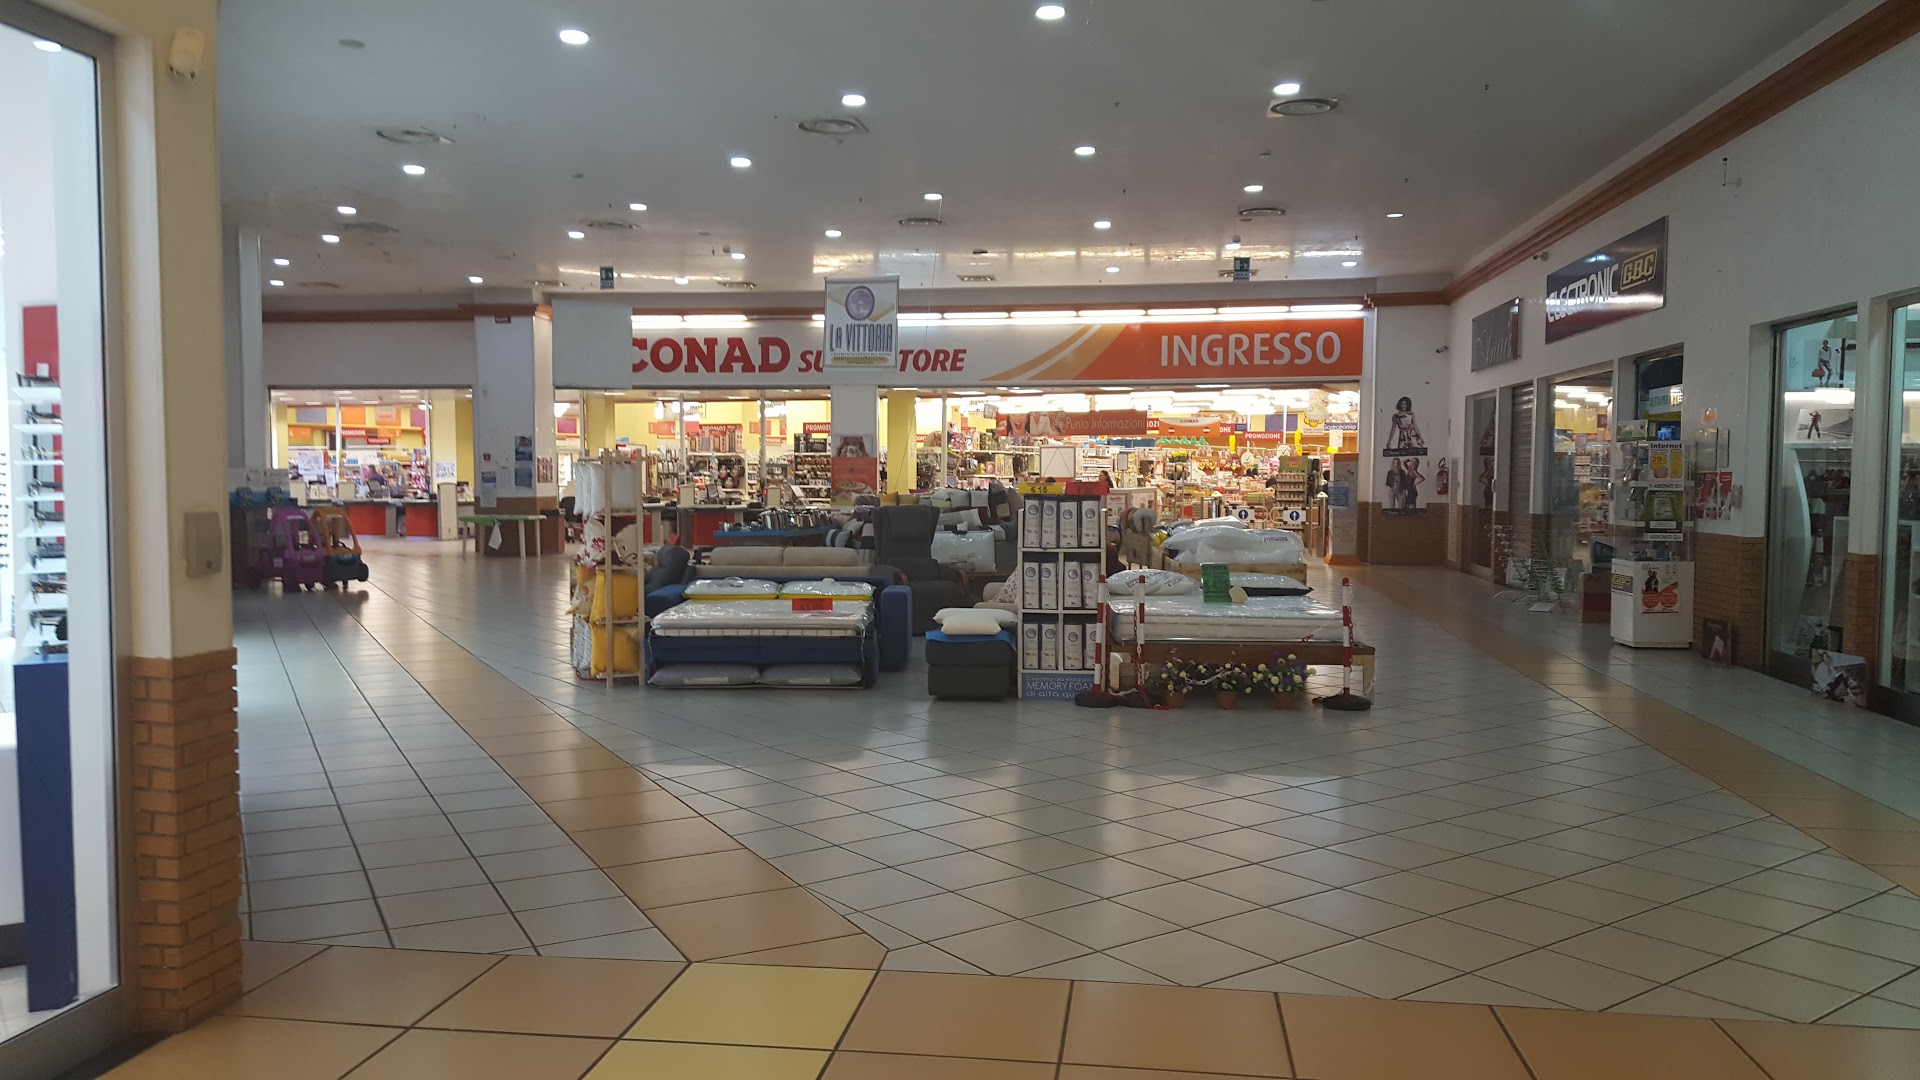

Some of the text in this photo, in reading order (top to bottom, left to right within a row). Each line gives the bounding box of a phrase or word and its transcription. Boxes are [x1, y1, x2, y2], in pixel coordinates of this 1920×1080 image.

[845, 323, 893, 353] VITTORIA
[1161, 331, 1342, 366] INGRESSO
[1066, 416, 1145, 430] Punto Informazioni
[1026, 682, 1068, 690] MEMORY
